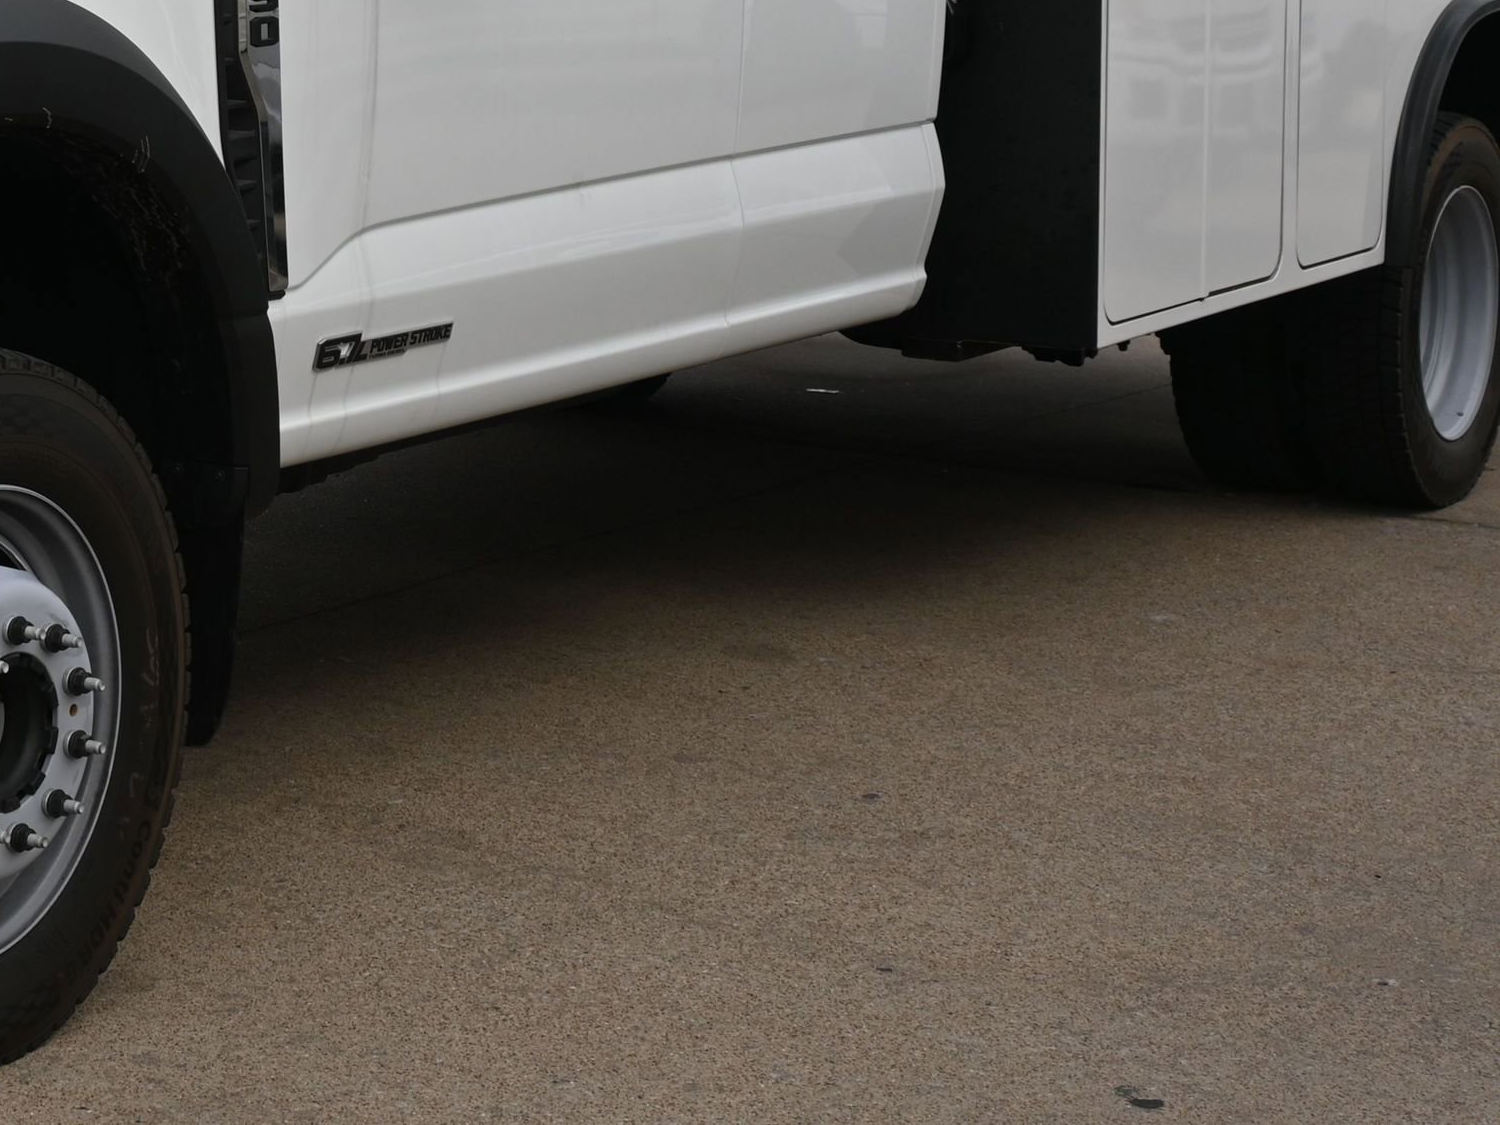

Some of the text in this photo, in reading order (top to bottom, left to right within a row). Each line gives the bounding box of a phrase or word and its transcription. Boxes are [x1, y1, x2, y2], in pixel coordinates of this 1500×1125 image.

[315, 324, 453, 371] 6.7L POWER STROKE
